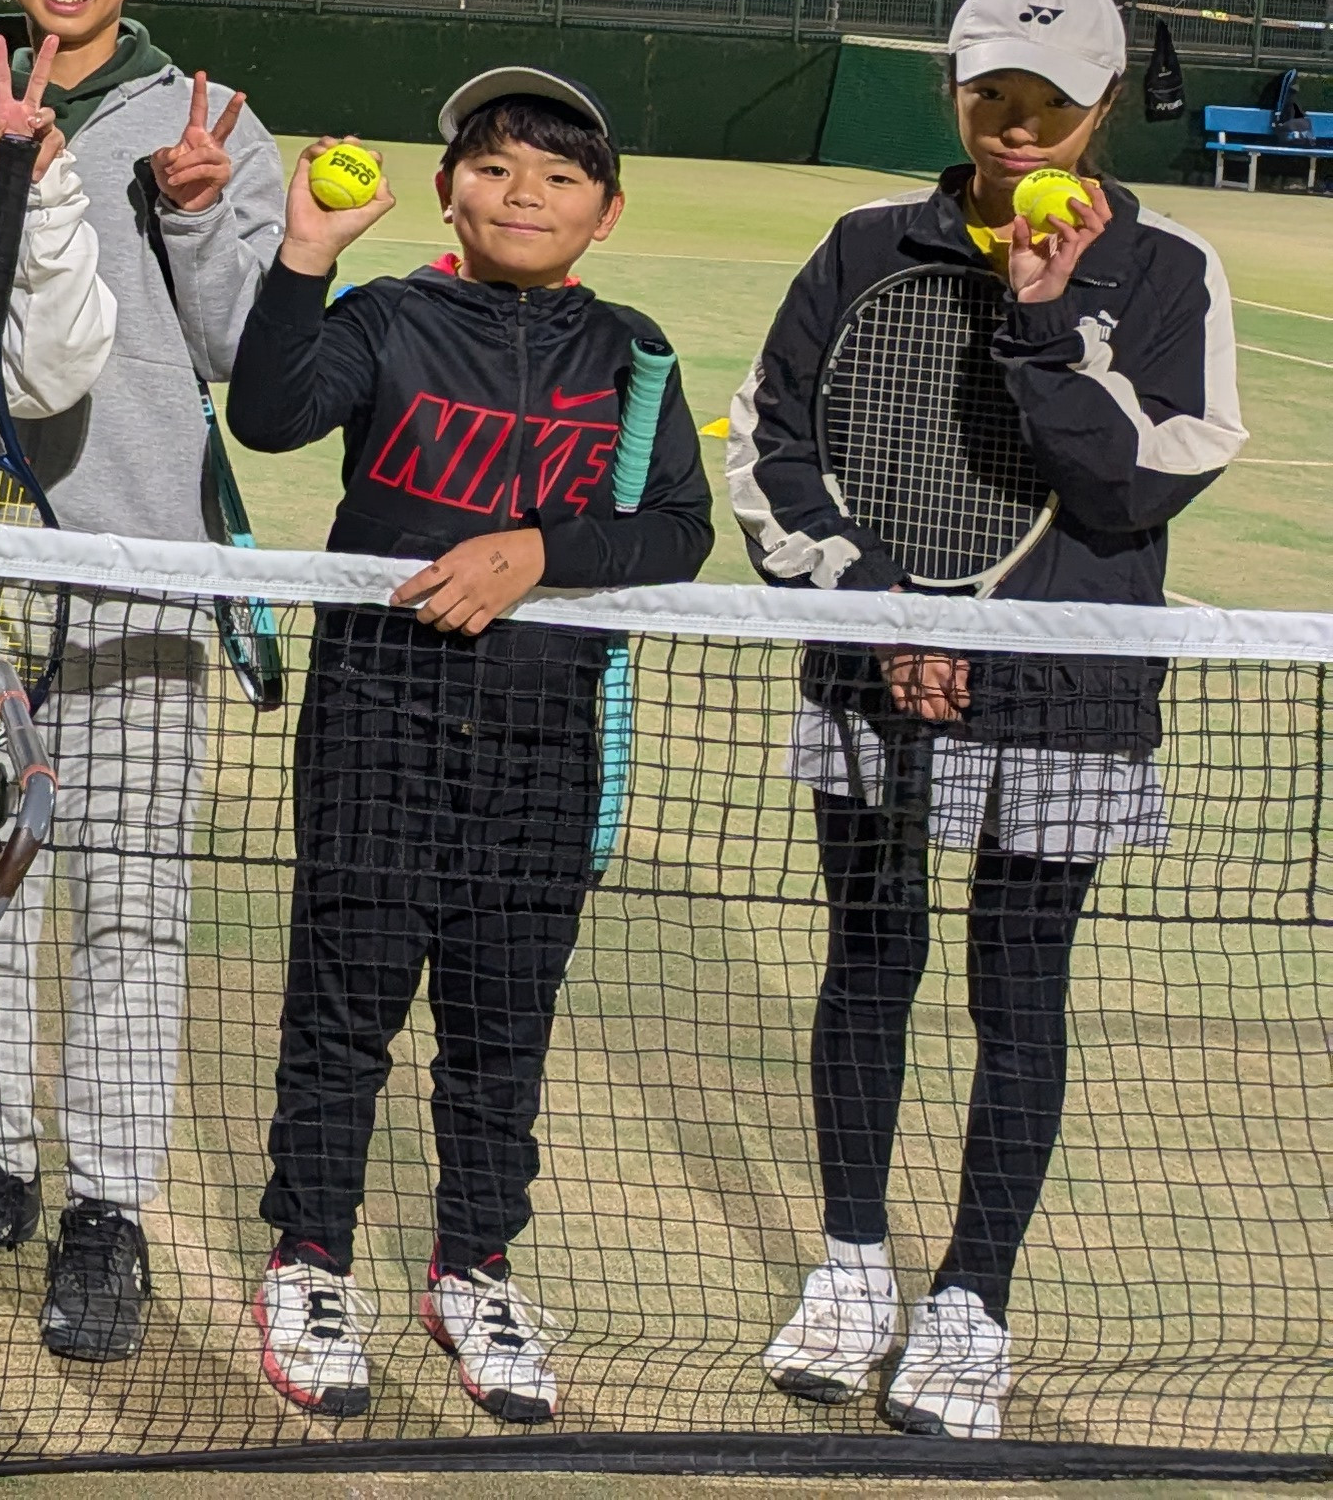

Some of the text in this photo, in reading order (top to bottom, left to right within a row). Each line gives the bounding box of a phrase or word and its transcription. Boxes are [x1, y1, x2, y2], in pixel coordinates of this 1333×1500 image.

[328, 159, 371, 186] PRO
[332, 150, 376, 180] HEAD
[369, 390, 619, 519] NIKE
